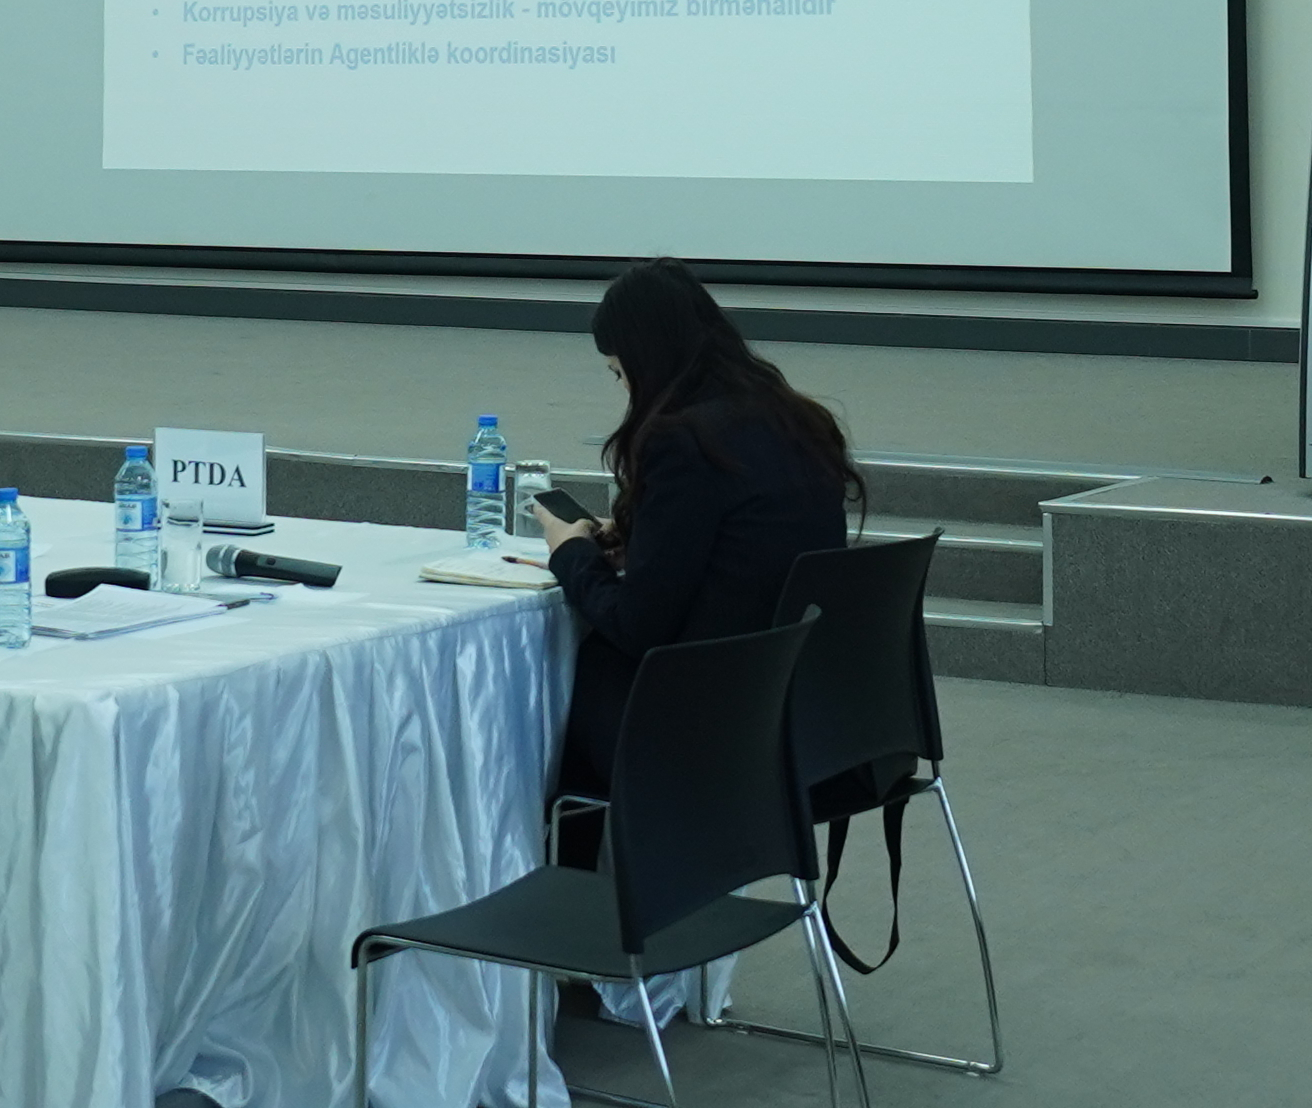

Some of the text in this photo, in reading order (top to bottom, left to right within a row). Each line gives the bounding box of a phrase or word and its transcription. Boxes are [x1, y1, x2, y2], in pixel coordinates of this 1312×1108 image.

[182, 0, 299, 28] Korrupsiya
[304, 4, 331, 22] və
[182, 40, 616, 71] Fəaliyyətlərin Agentliklə koordinasiyası
[171, 459, 247, 488] PTDA
